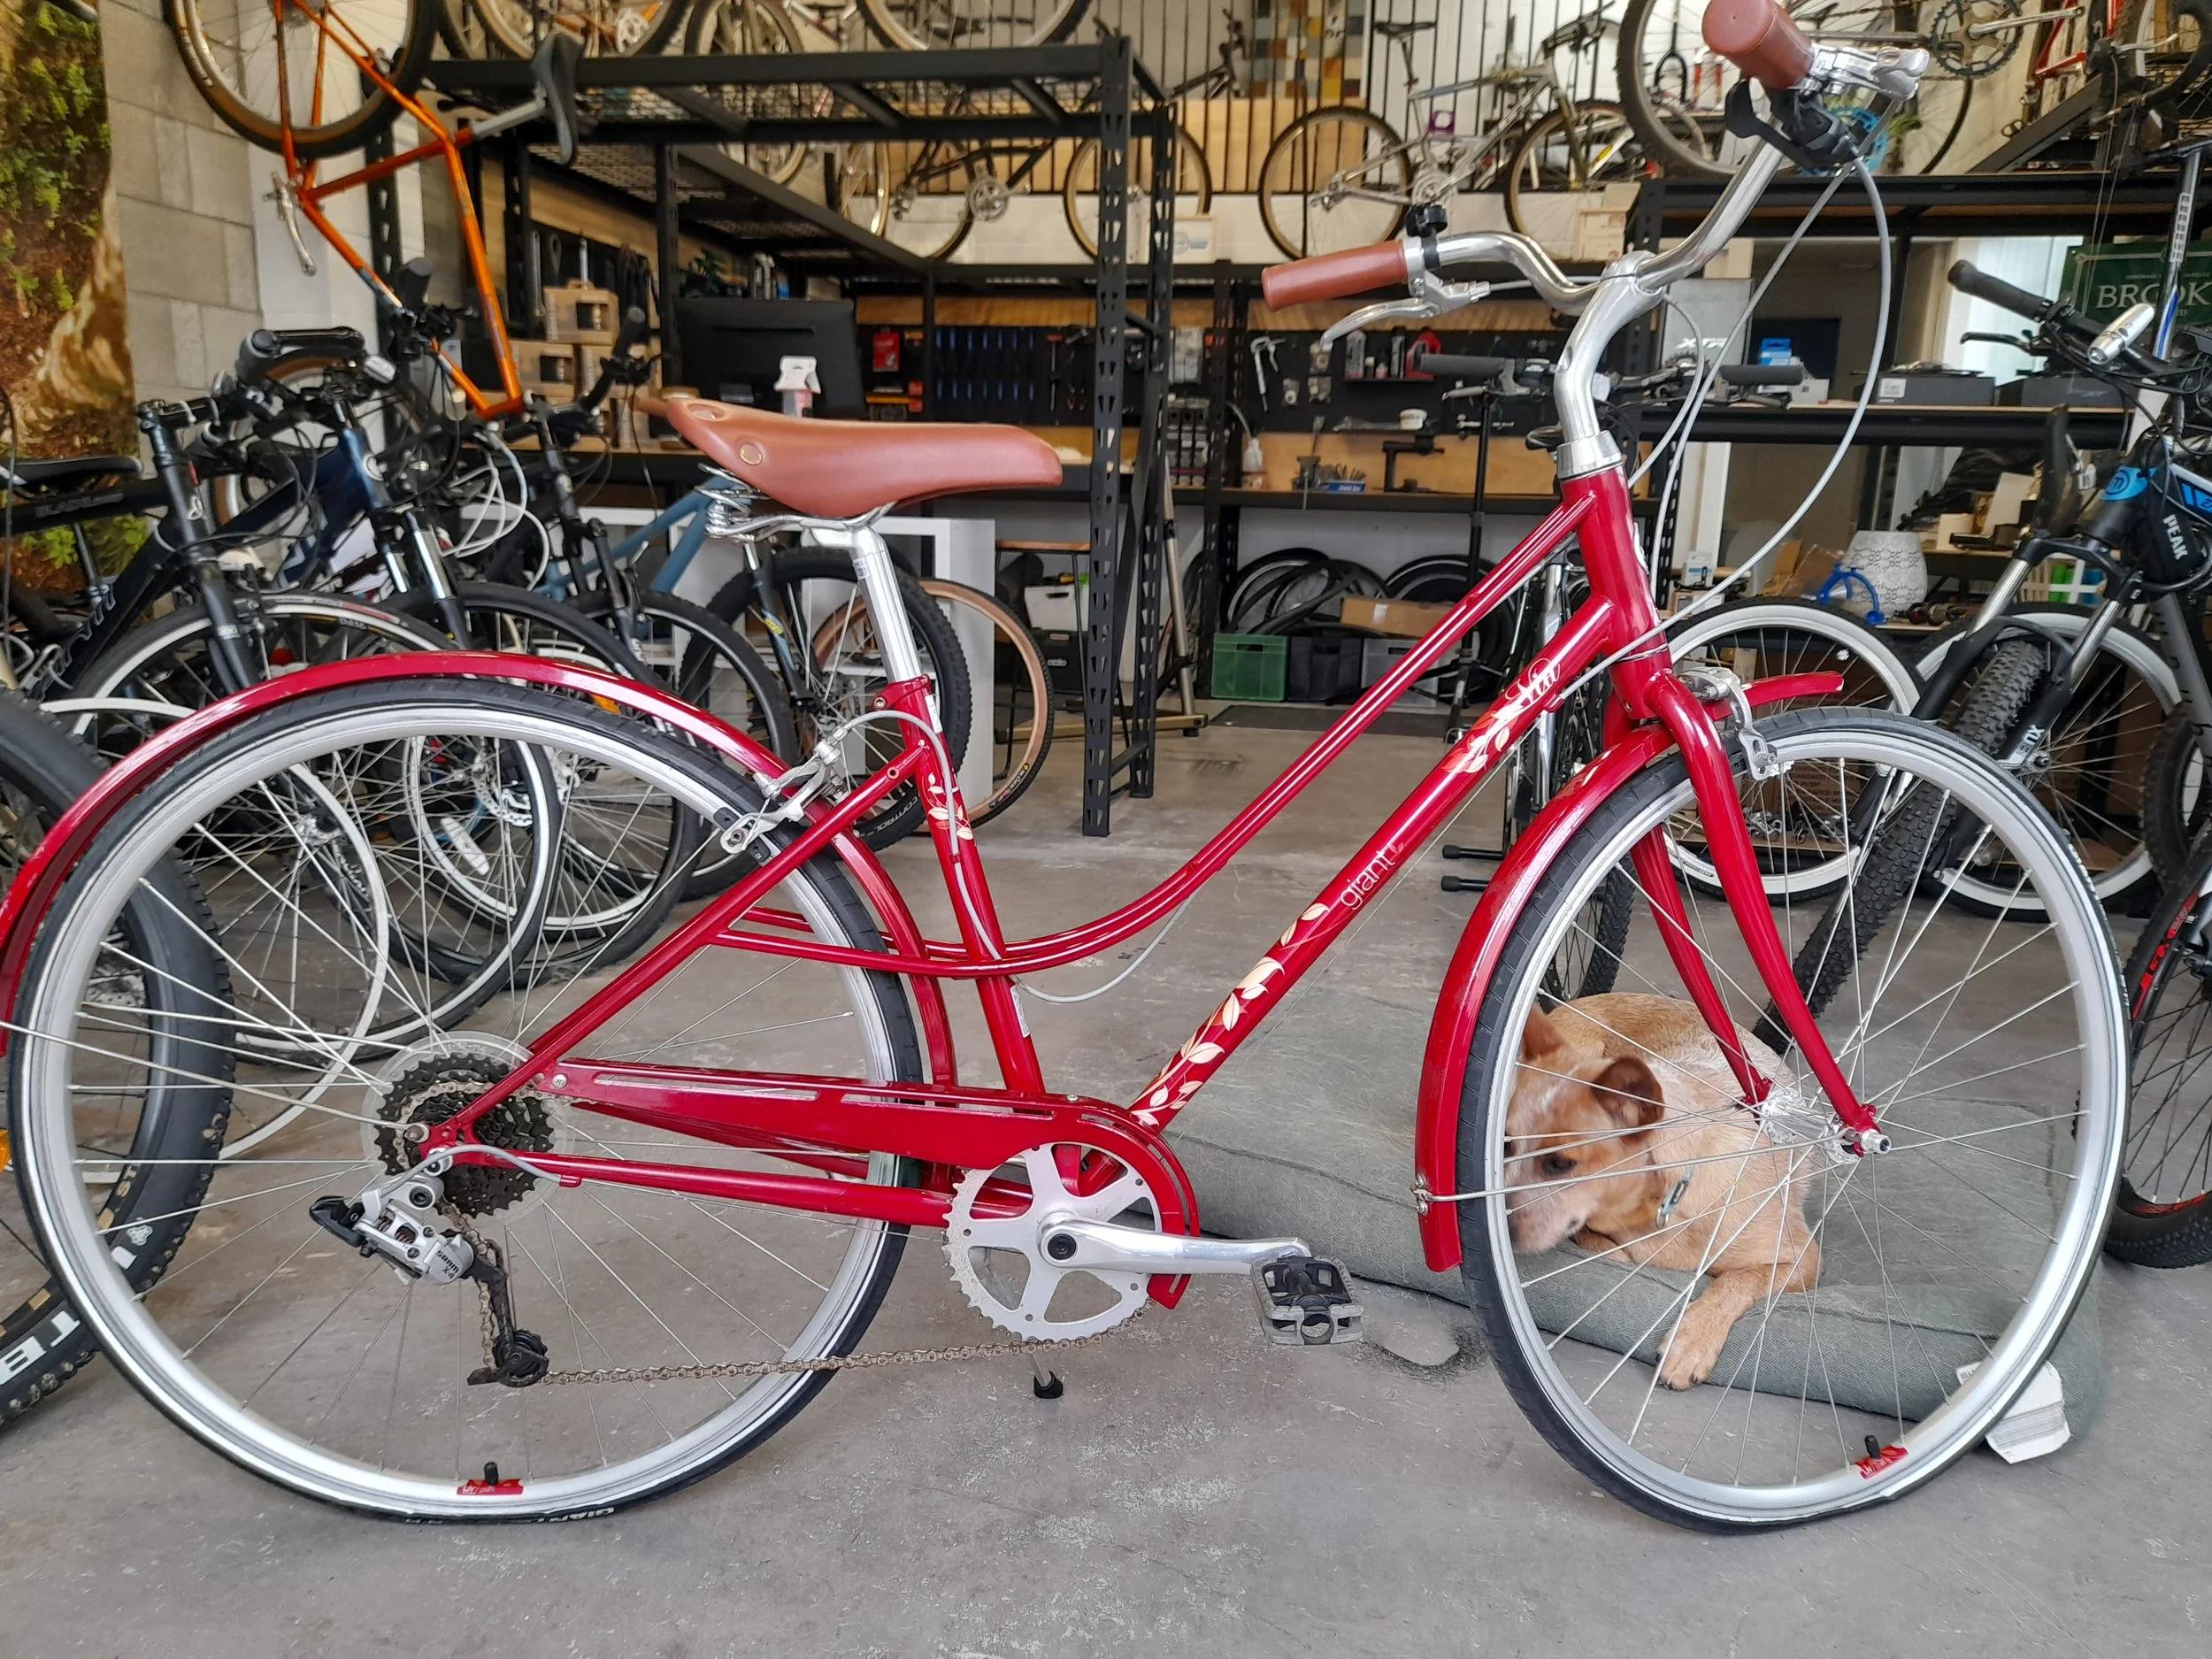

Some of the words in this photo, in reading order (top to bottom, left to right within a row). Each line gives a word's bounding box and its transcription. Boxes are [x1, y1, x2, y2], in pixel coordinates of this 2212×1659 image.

[2162, 514, 2188, 561] PEAK
[877, 795, 918, 833] CONTROL
[1340, 850, 1396, 910] giant
[436, 1250, 459, 1273] SRAM
